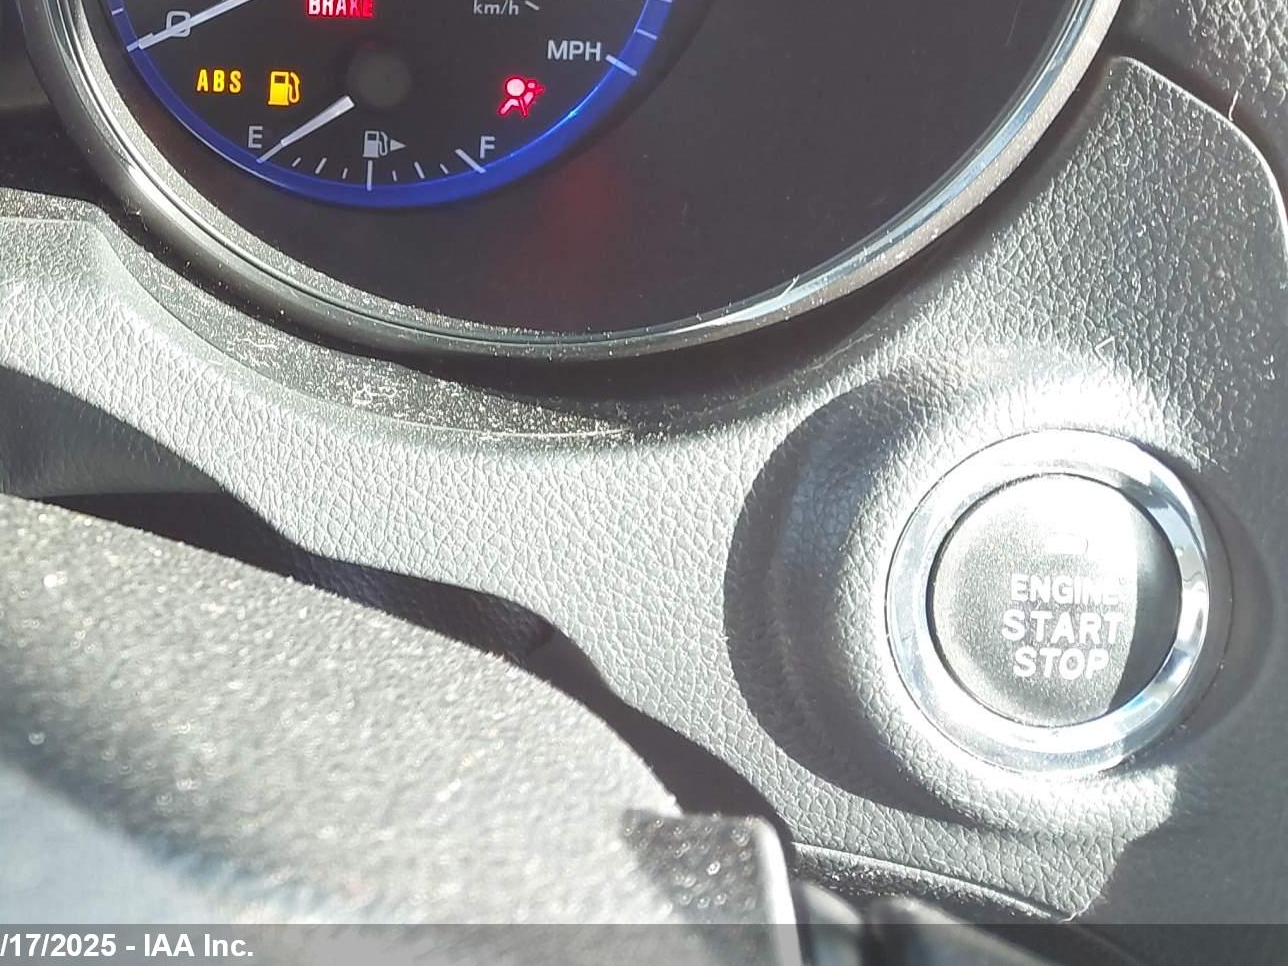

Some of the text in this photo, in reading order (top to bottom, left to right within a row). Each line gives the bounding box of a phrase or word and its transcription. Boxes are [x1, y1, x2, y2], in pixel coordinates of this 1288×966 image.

[473, 0, 520, 16] km/h
[165, 11, 192, 37] 0
[548, 40, 602, 62] MPH
[196, 69, 241, 93] ABS
[248, 127, 263, 148] E
[479, 136, 495, 158] F
[1002, 610, 1122, 645] START
[1014, 648, 1109, 680] STOP
